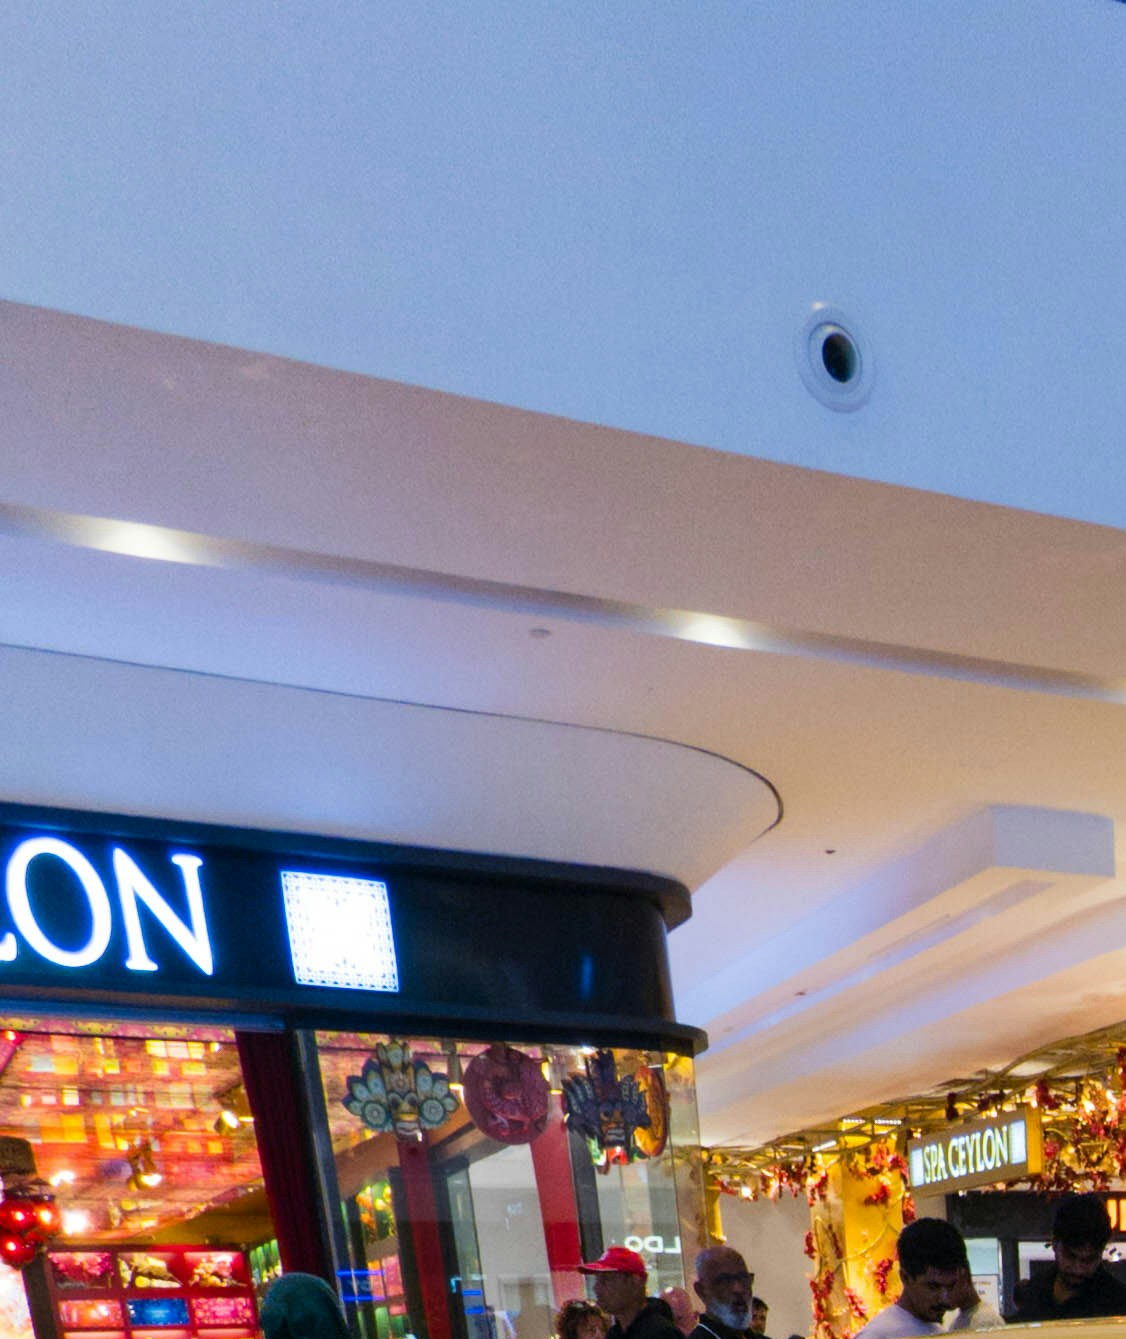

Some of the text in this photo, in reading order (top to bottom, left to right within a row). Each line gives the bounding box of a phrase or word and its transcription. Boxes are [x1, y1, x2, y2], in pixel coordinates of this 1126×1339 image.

[0, 836, 214, 976] ON
[923, 1125, 1009, 1184] SPA CEYLON
